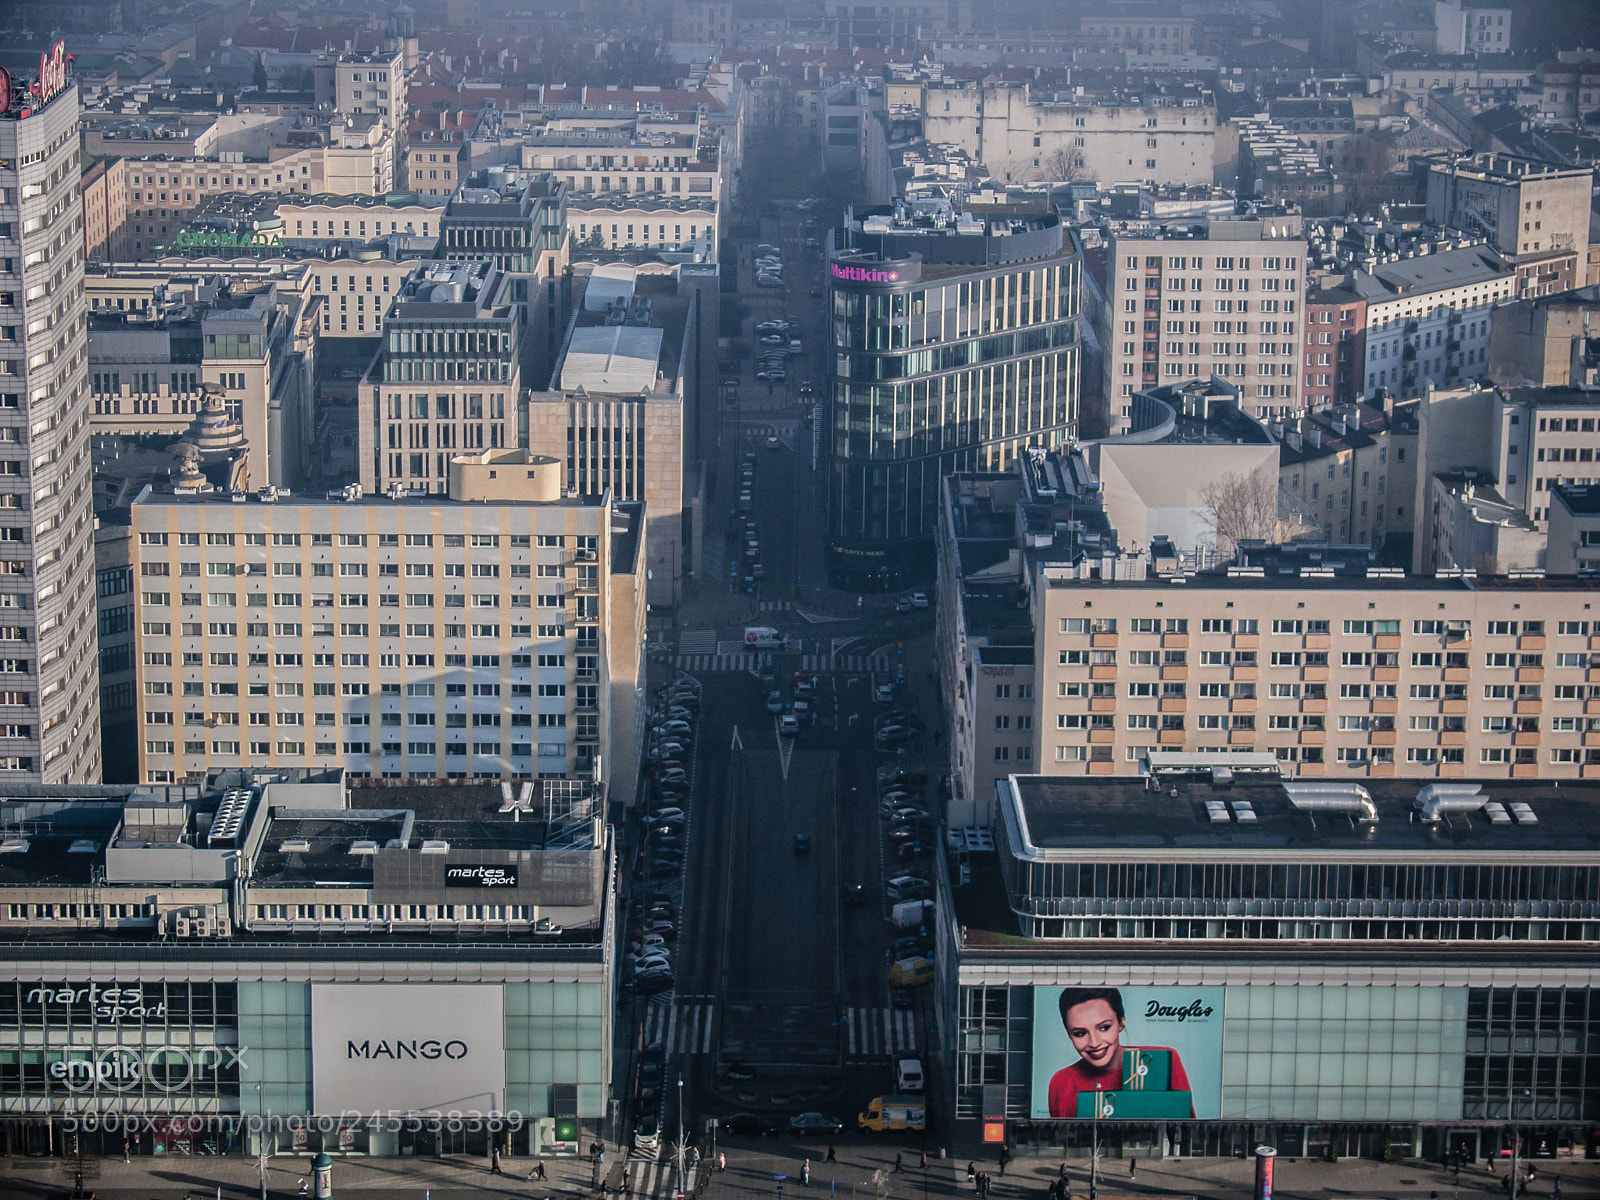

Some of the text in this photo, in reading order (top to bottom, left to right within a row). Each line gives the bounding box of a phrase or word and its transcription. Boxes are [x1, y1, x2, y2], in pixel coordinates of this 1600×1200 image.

[177, 232, 284, 248] GROMADA
[830, 262, 899, 282] Multikino
[448, 866, 505, 877] martes
[482, 876, 515, 886] sport
[26, 983, 141, 1004] martes
[96, 1002, 167, 1023] sport
[1144, 998, 1213, 1022] Douglas
[347, 1040, 468, 1060] MANGO
[50, 1051, 139, 1082] empik
